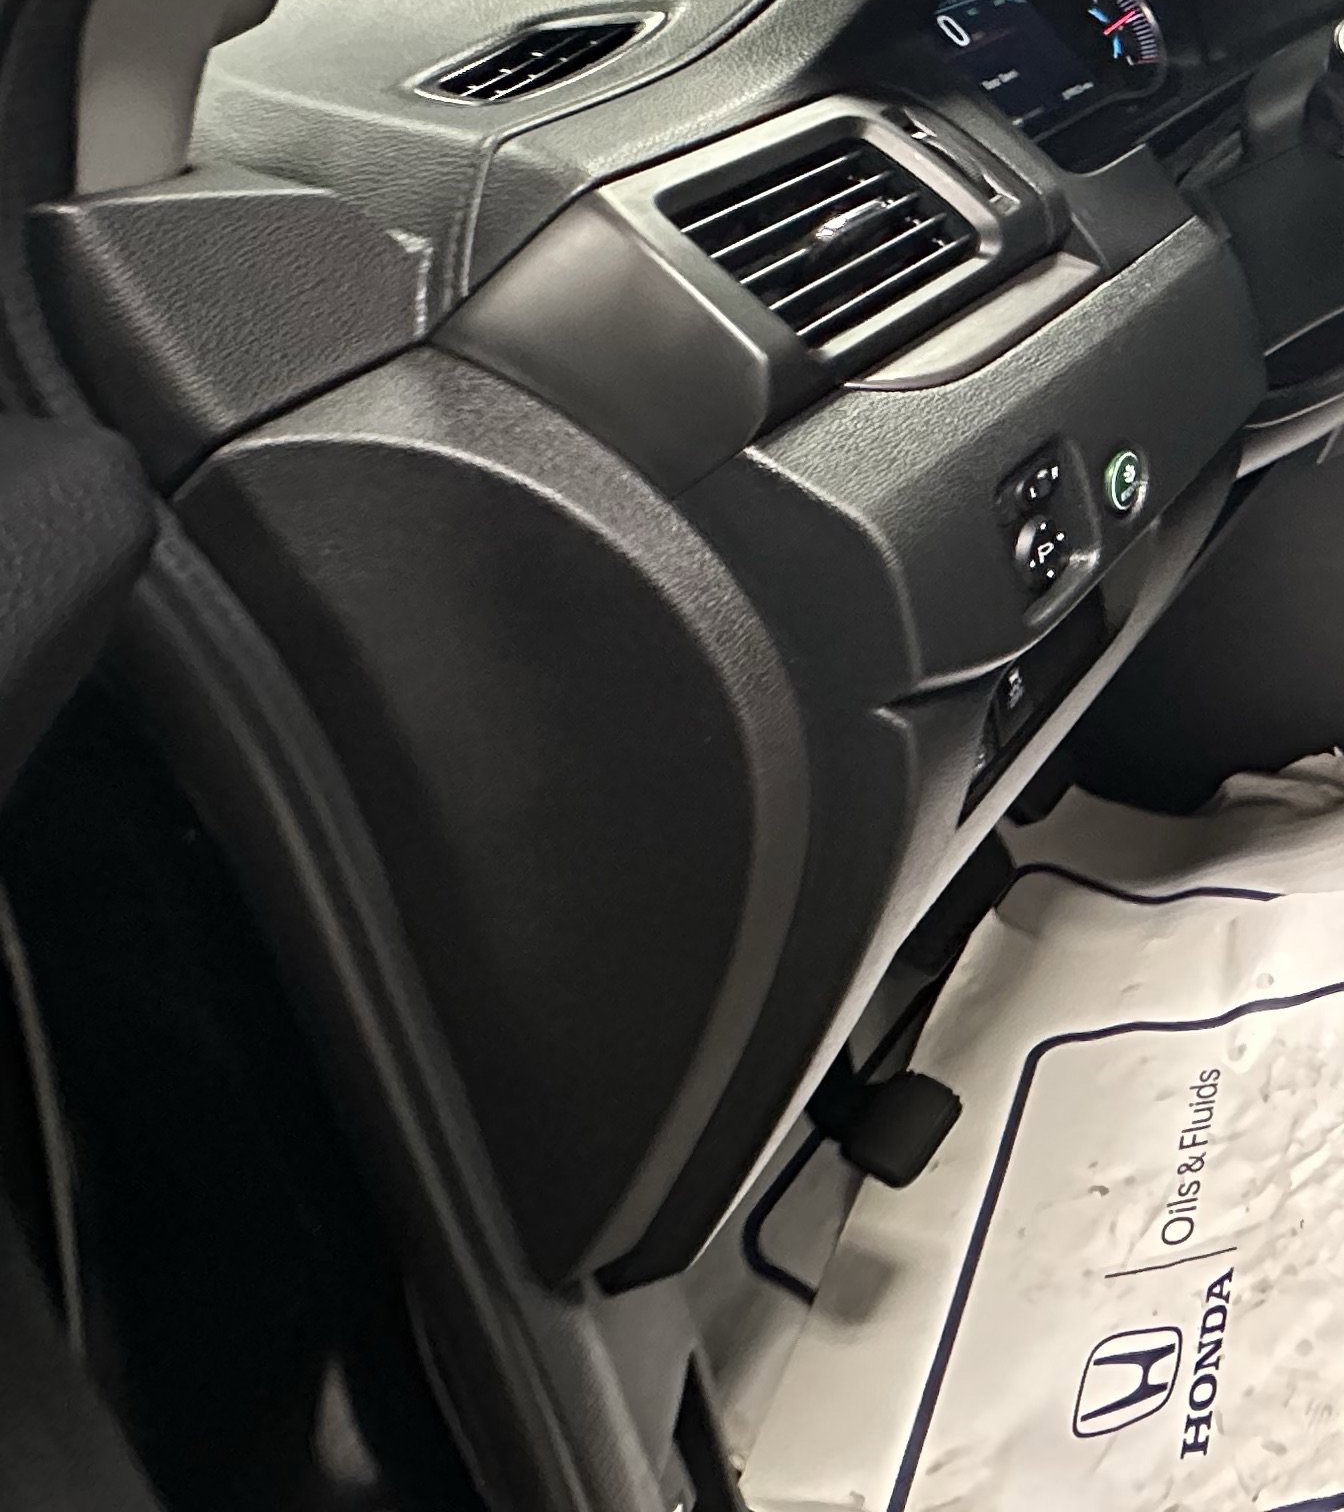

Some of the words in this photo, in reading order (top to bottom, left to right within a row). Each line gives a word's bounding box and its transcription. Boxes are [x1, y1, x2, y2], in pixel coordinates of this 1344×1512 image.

[1178, 1068, 1222, 1151] Fluids
[1176, 1151, 1207, 1176] &
[1160, 1180, 1201, 1246] Oils
[1180, 1266, 1236, 1460] HONDA
